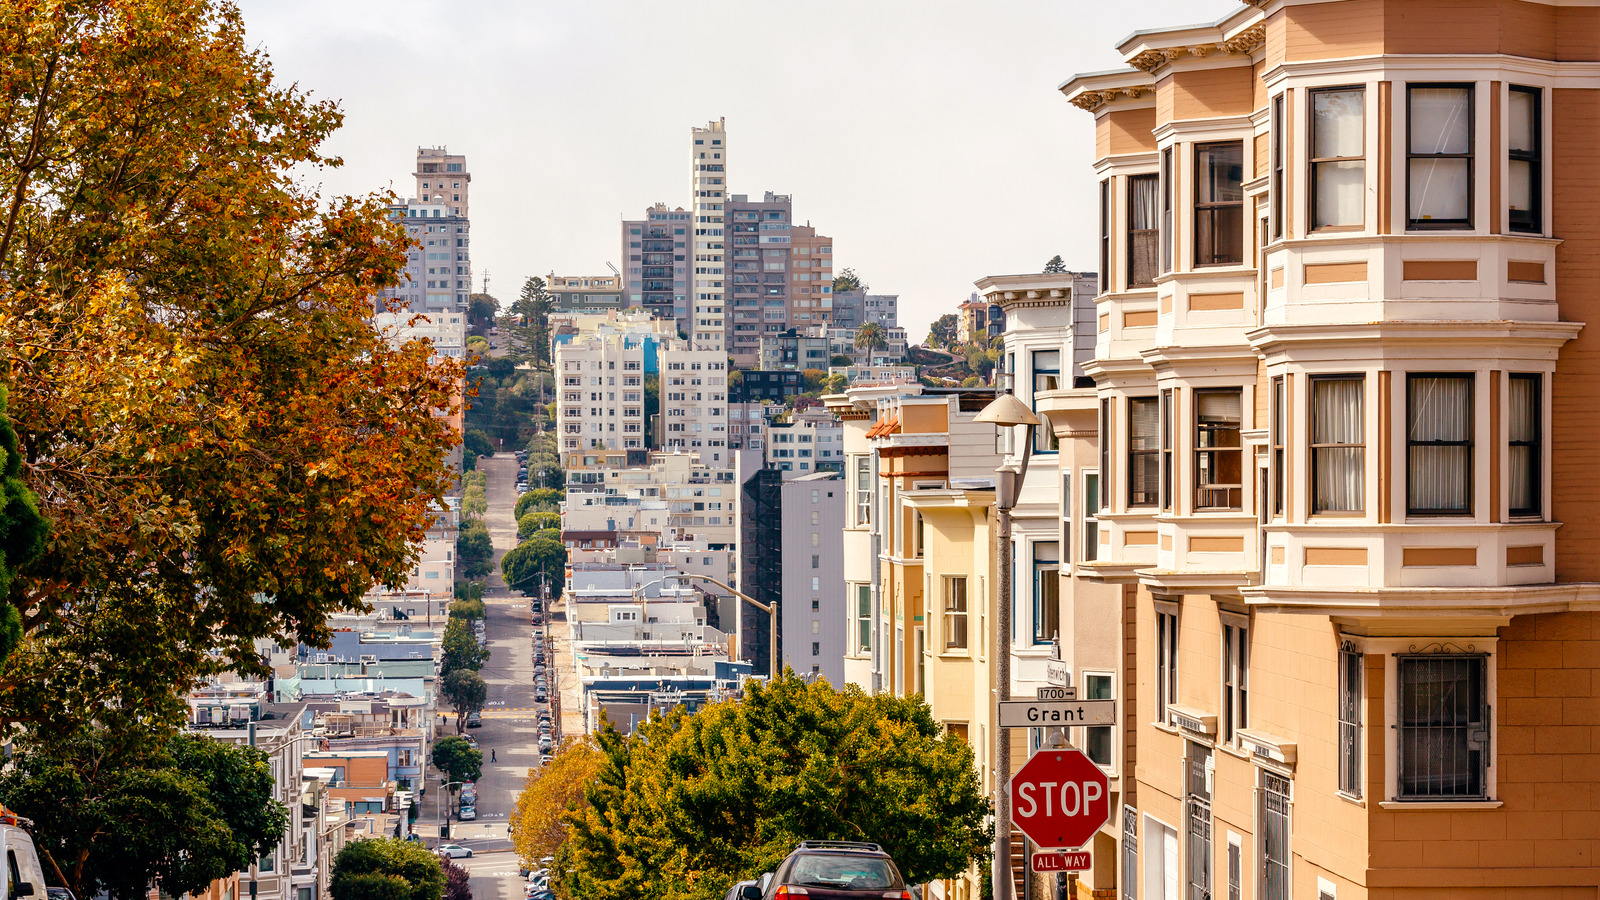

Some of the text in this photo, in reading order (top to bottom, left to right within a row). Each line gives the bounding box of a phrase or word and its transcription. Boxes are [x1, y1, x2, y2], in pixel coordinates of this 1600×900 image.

[1040, 689, 1064, 699] 1700
[1027, 706, 1084, 722] Grant
[1017, 780, 1102, 818] STOP
[1037, 856, 1087, 868] ALL WAY
